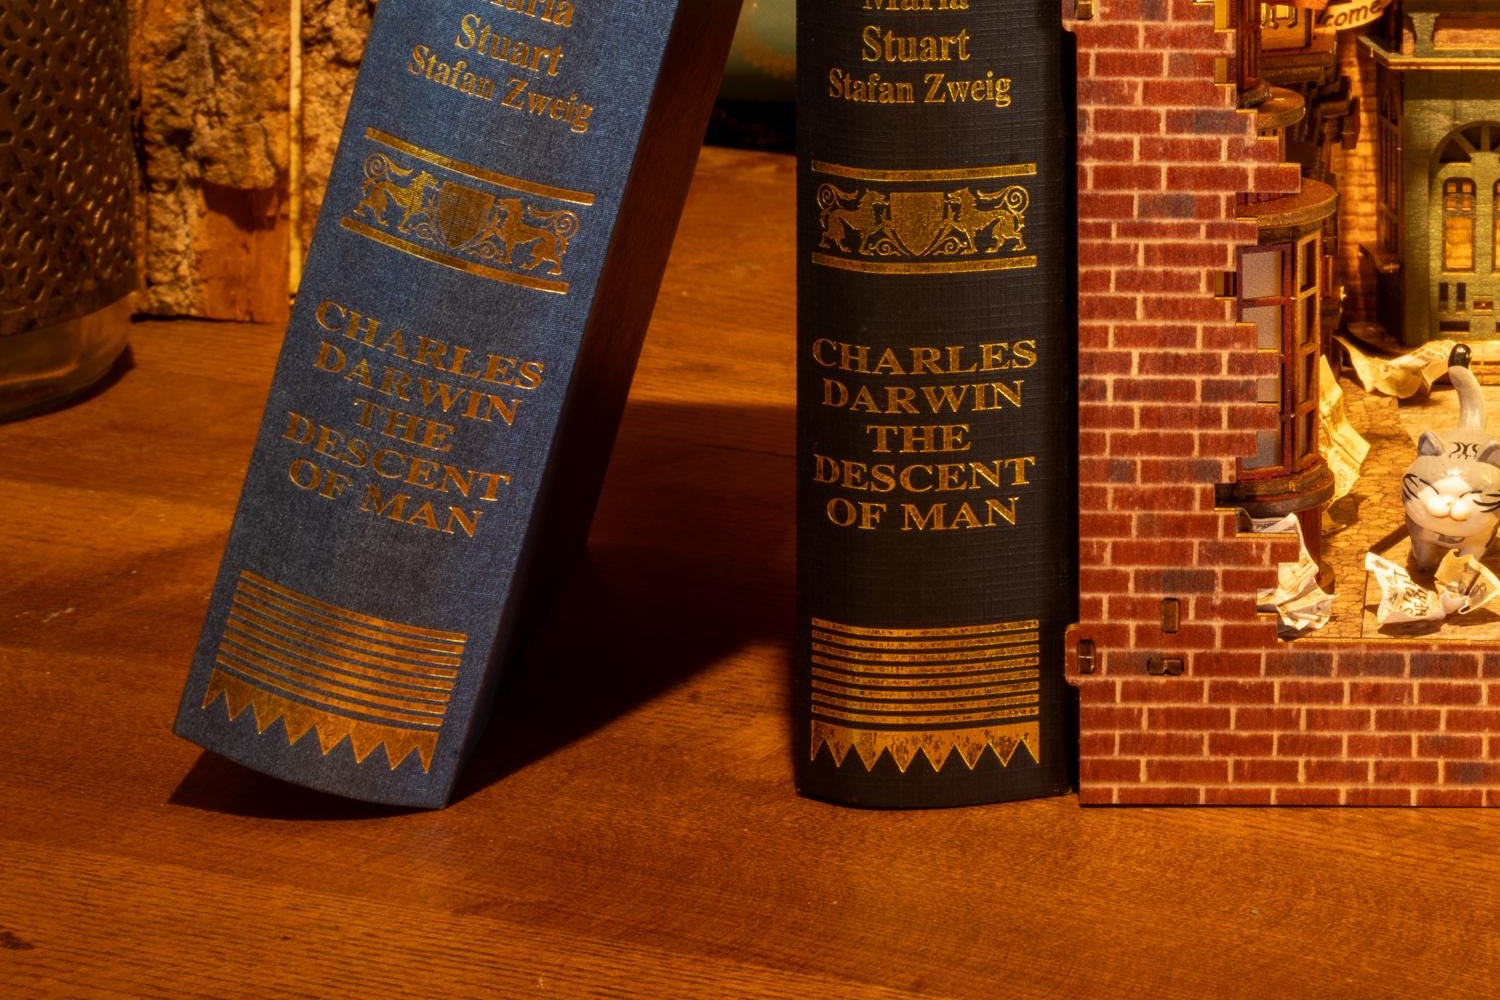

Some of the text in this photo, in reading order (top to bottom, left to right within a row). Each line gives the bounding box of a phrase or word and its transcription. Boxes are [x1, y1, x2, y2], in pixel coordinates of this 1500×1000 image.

[454, 12, 564, 78] Stuart
[861, 25, 971, 63] Stuart
[407, 42, 595, 135] Stafan Zweig
[828, 66, 1012, 108] Stafan Zweig
[314, 300, 547, 391] CHARLES
[811, 337, 1039, 375] CHARLES
[313, 341, 526, 427] DARWIN
[821, 377, 1025, 414] DARWIN
[353, 398, 456, 454] THE
[866, 423, 972, 453] THE
[281, 411, 512, 502] DESCENT
[813, 453, 1036, 493] DESCENT
[287, 458, 485, 539] OF MAN
[826, 496, 1020, 531] OF MAN
